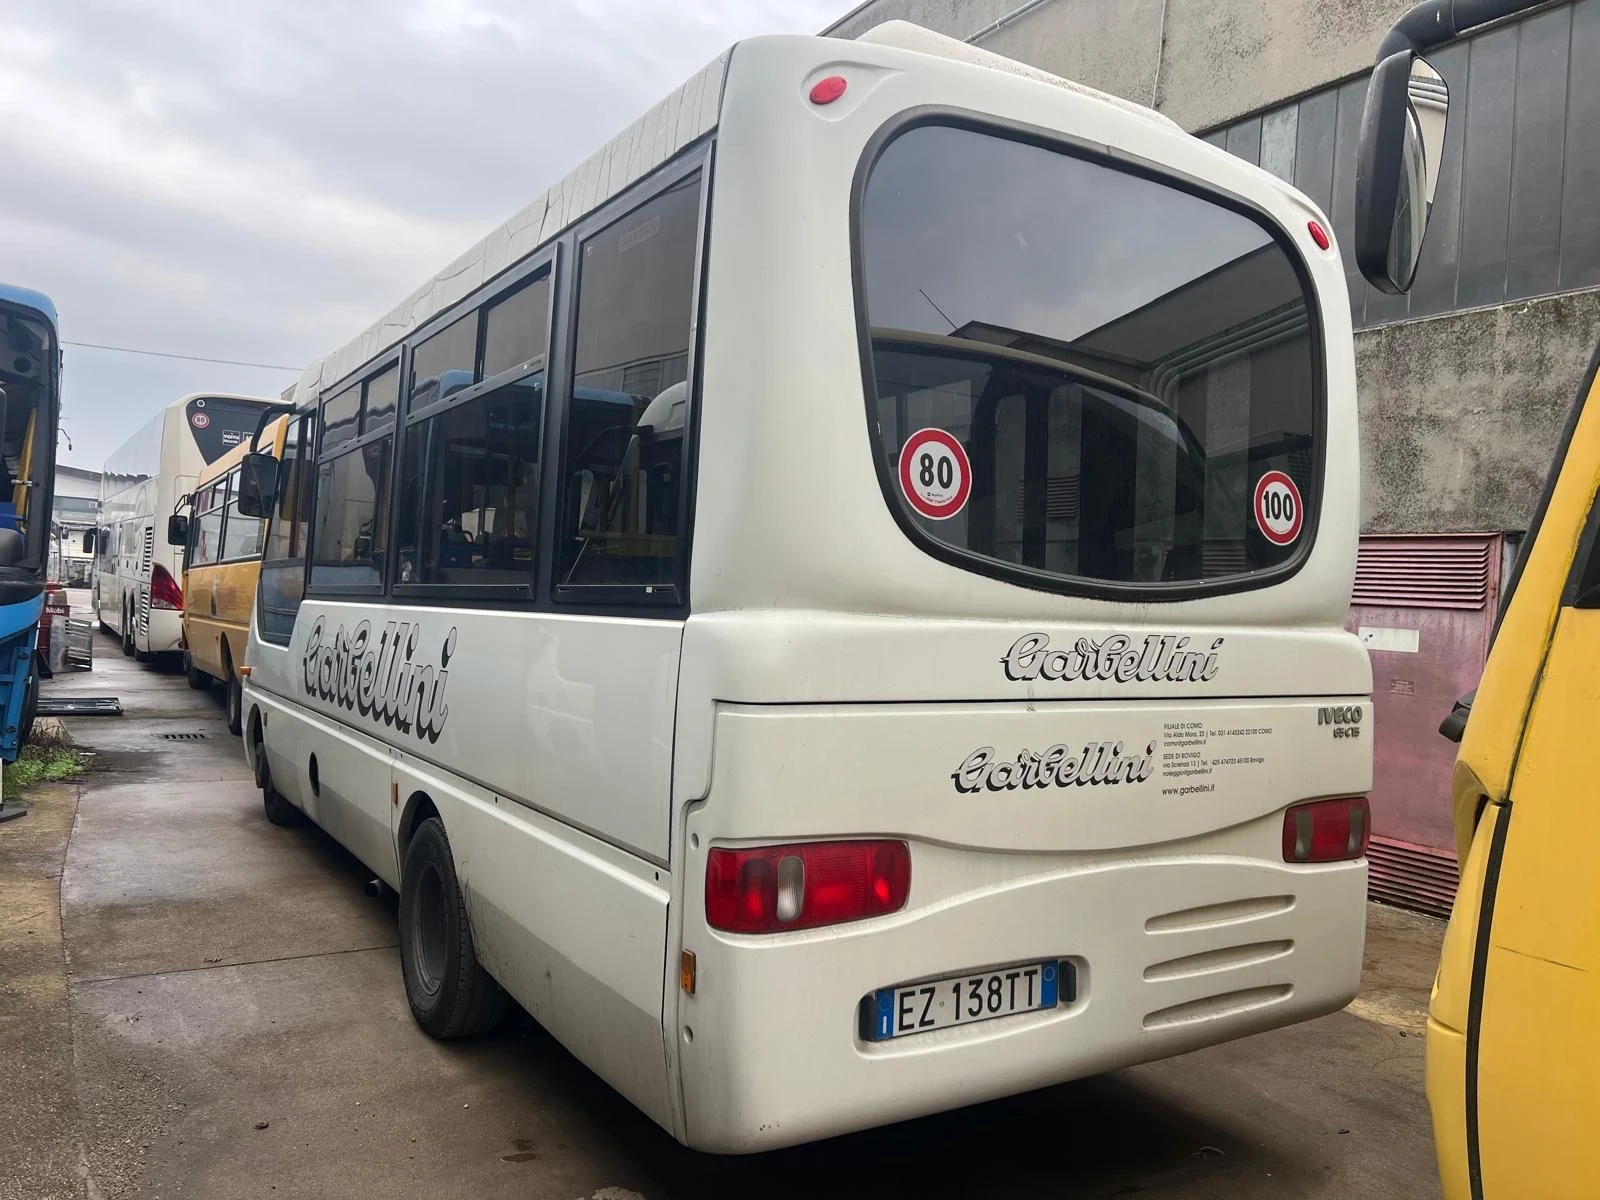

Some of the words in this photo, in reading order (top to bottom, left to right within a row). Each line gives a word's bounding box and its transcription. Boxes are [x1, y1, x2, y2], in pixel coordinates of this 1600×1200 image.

[919, 452, 953, 489] 80
[1263, 491, 1293, 522] 100
[302, 614, 458, 745] Garbellini
[999, 632, 1224, 683] Garbellini
[1317, 706, 1362, 725] IVECO
[951, 739, 1158, 794] Garbellini
[1162, 784, 1215, 796] www.garbellini.it
[898, 986, 936, 1032] EZ
[952, 969, 1038, 1021] 138TT
